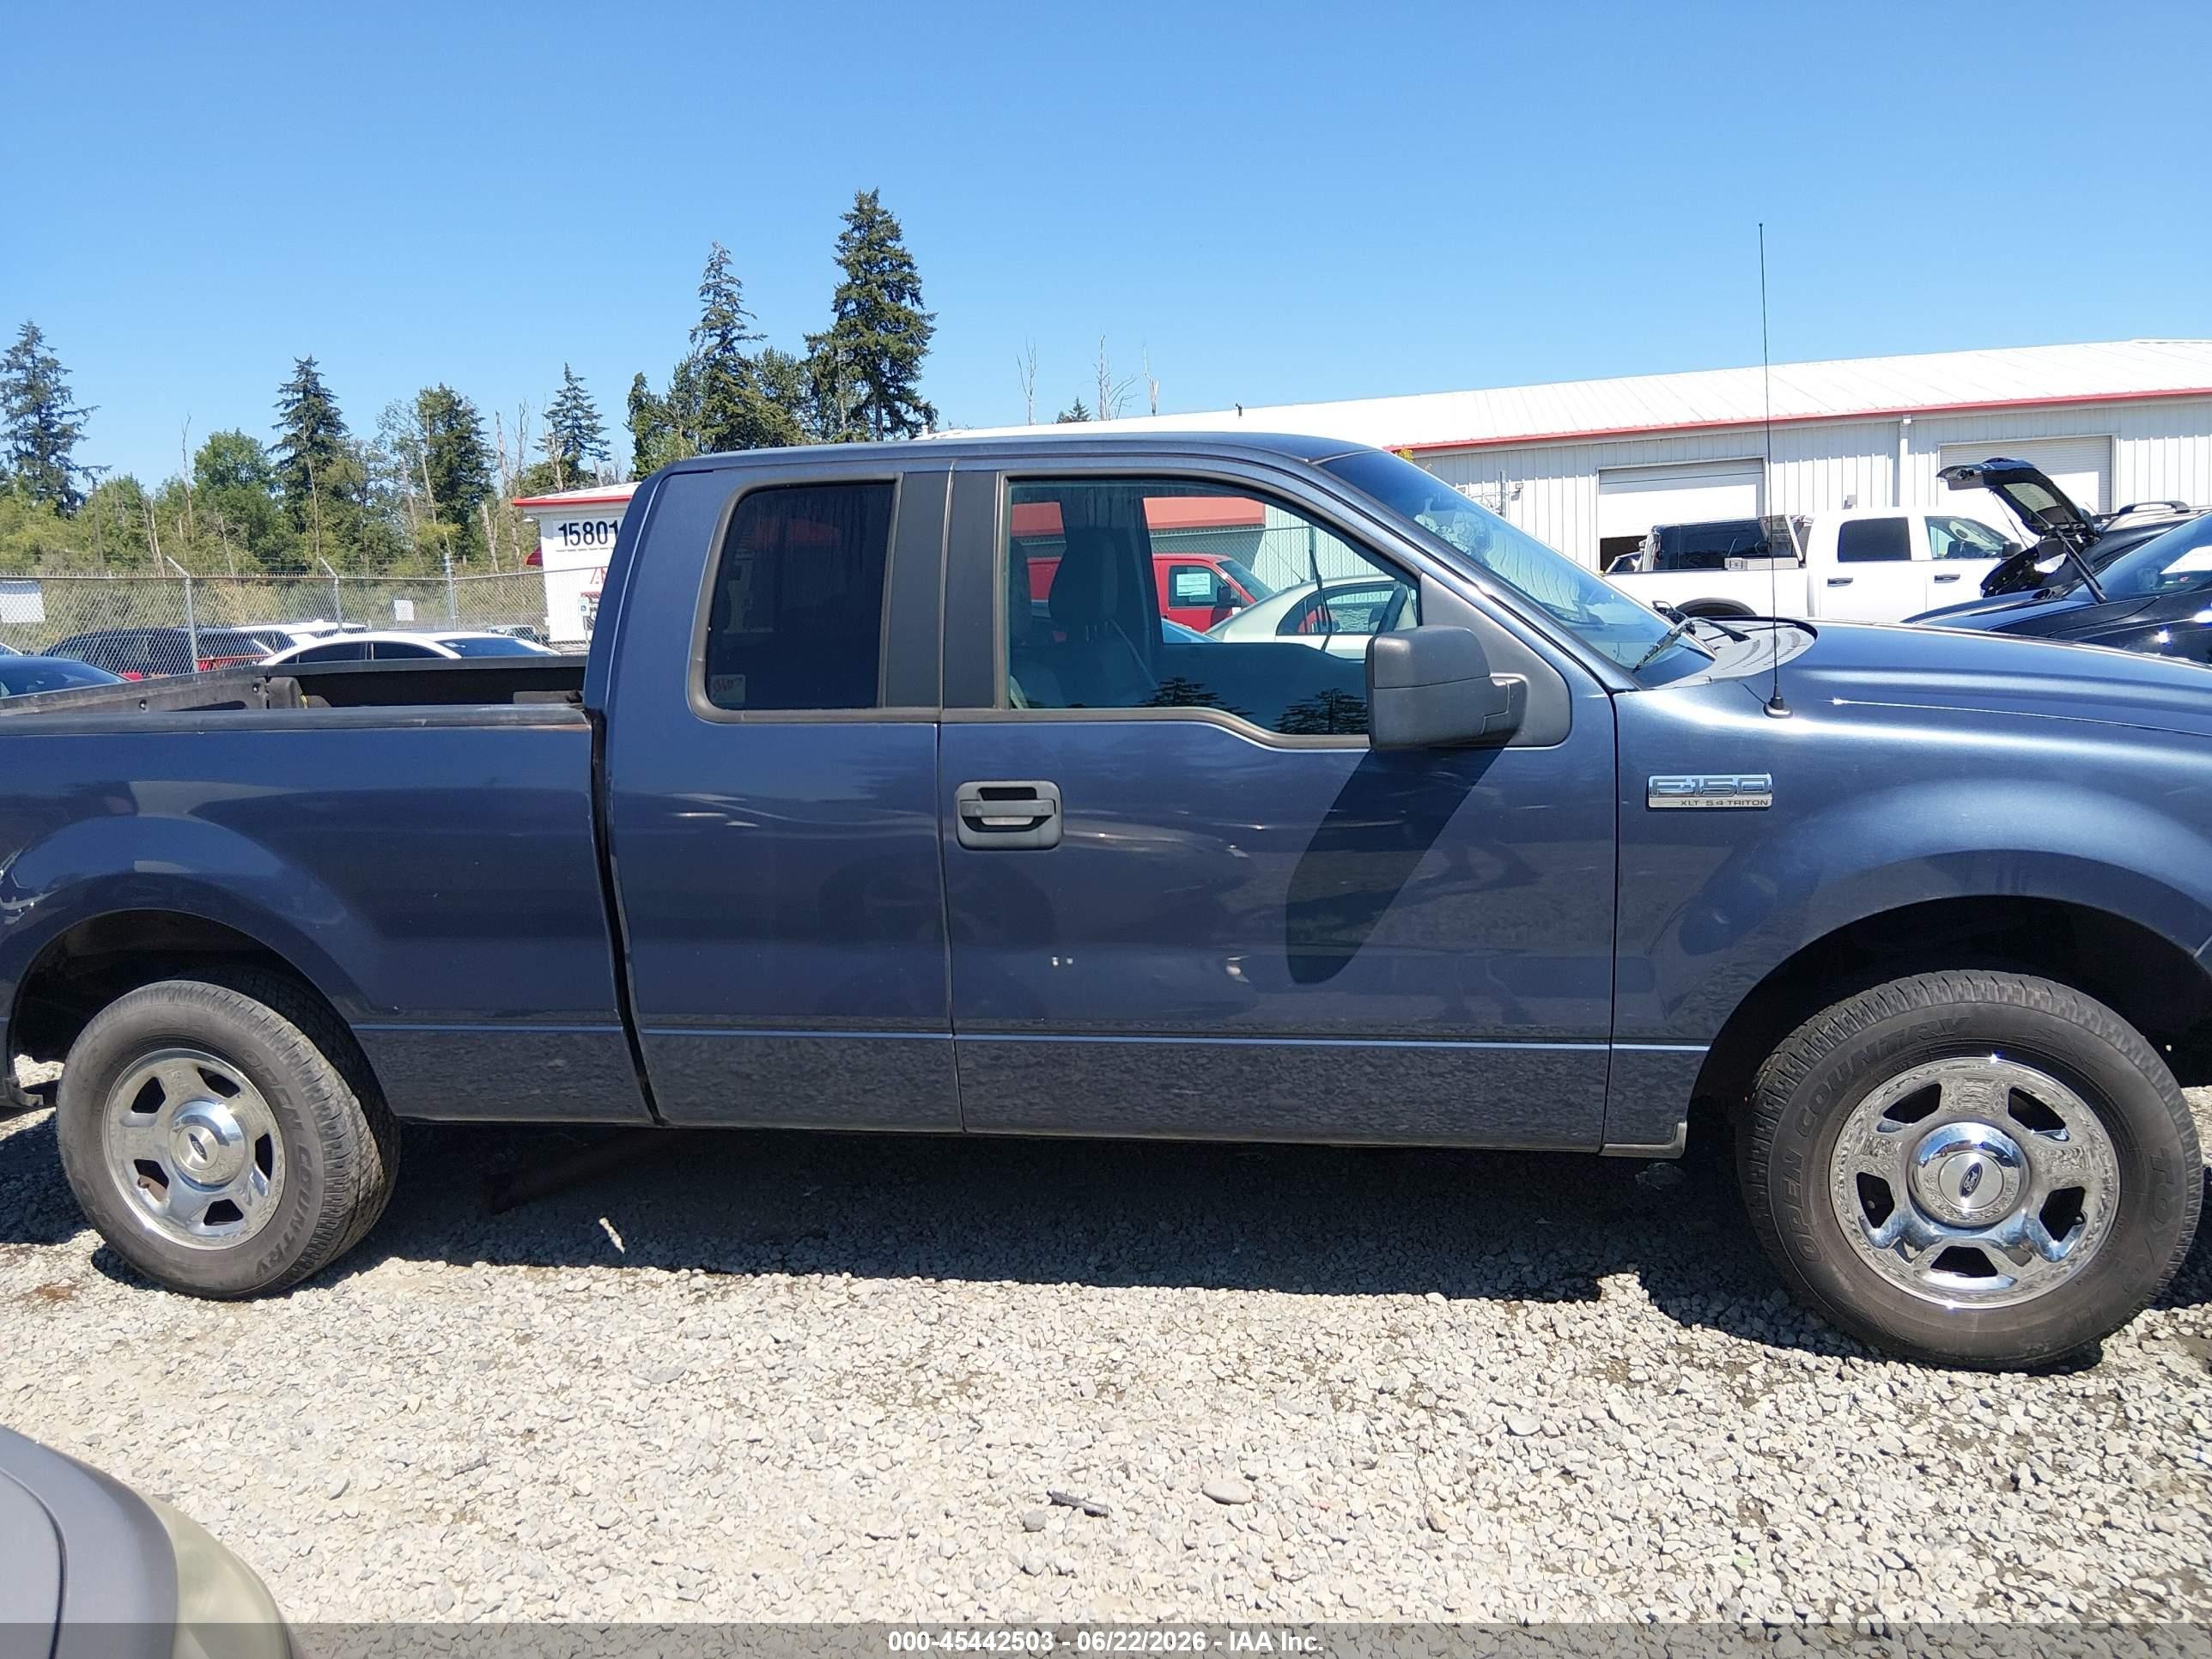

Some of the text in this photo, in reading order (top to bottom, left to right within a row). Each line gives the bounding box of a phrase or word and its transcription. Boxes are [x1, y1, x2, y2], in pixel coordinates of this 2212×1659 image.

[558, 520, 619, 546] 15801
[1781, 1016, 1972, 1262] OPEN COUNTRY
